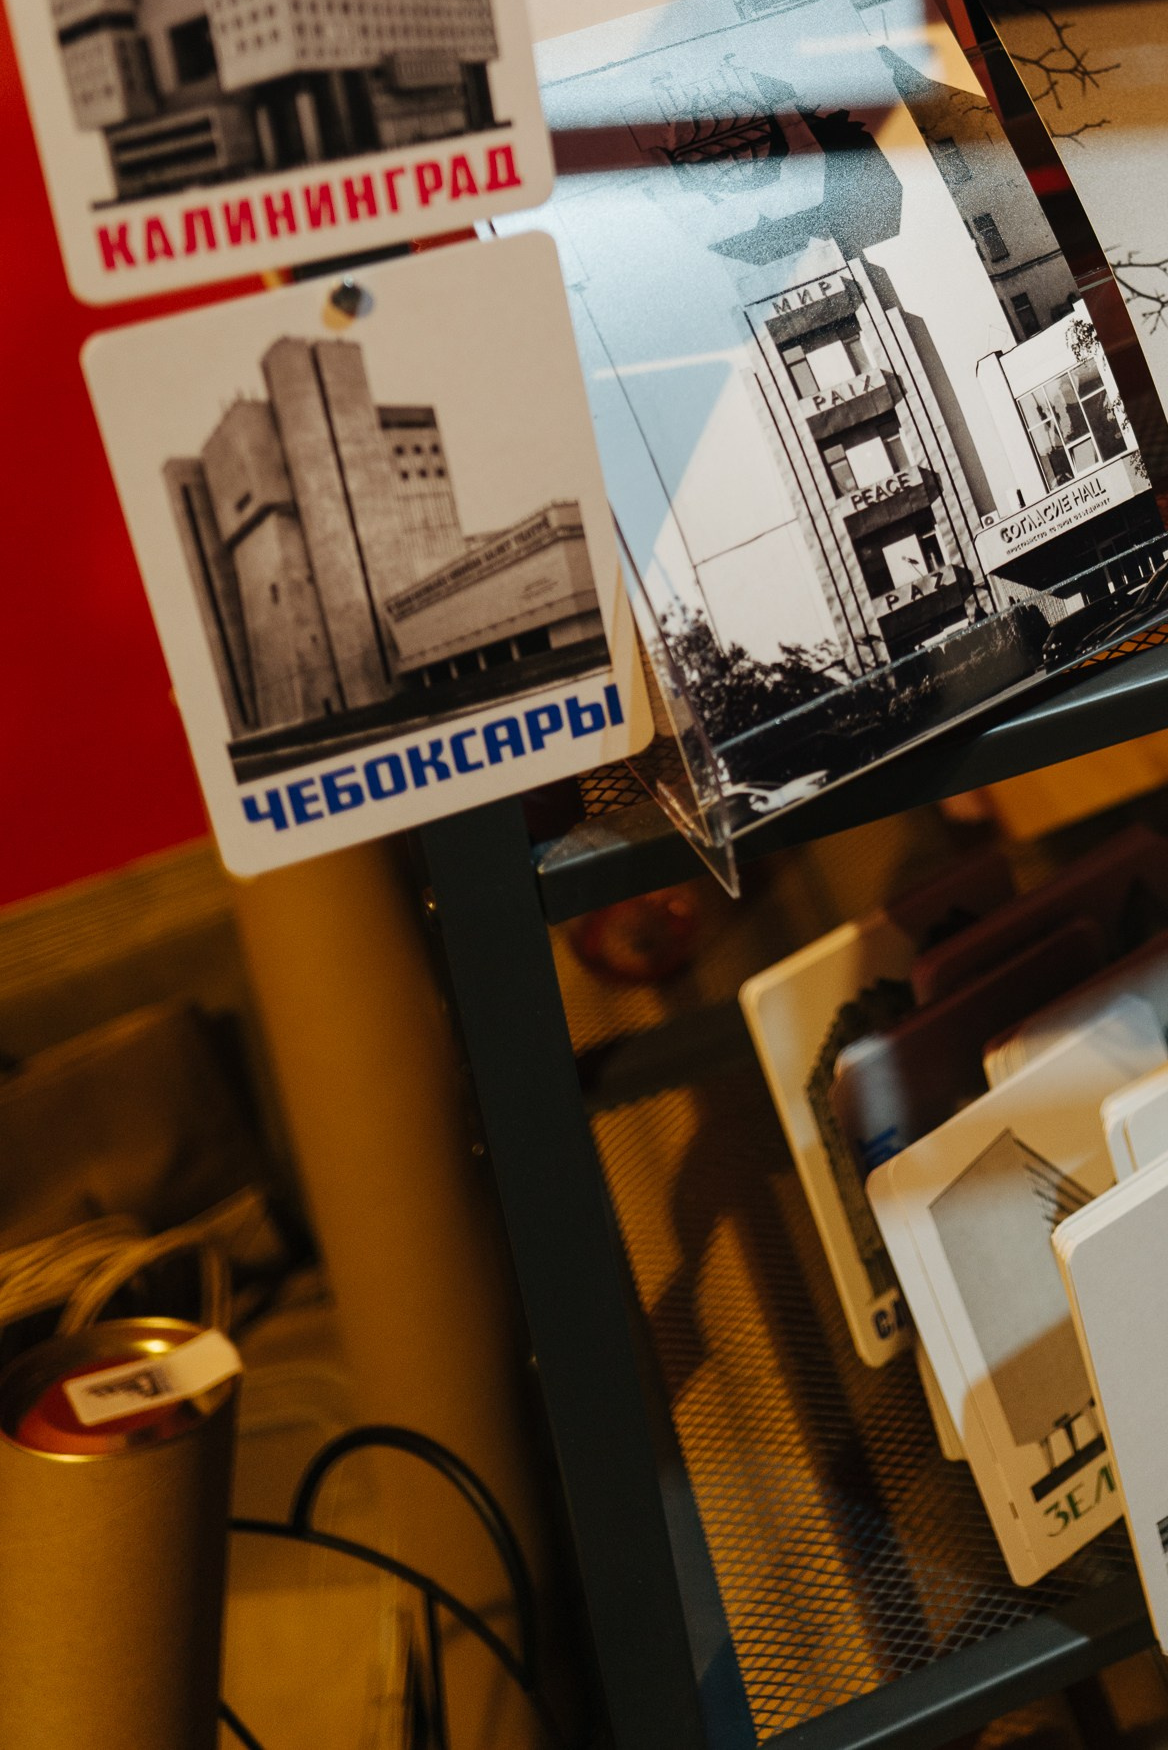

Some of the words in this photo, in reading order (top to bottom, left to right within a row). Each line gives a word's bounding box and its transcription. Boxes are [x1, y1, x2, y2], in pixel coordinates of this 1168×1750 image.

[96, 144, 524, 273] КАЛИНИНГРАД
[772, 281, 832, 314] МИР
[811, 374, 876, 411] PAIX
[851, 472, 911, 511] PEACE
[1000, 494, 1073, 544] СОГЛАСИЕ
[1072, 478, 1107, 507] HALL
[885, 572, 944, 611] PAZ
[240, 684, 625, 832] ЧЕБОКСАРЫ
